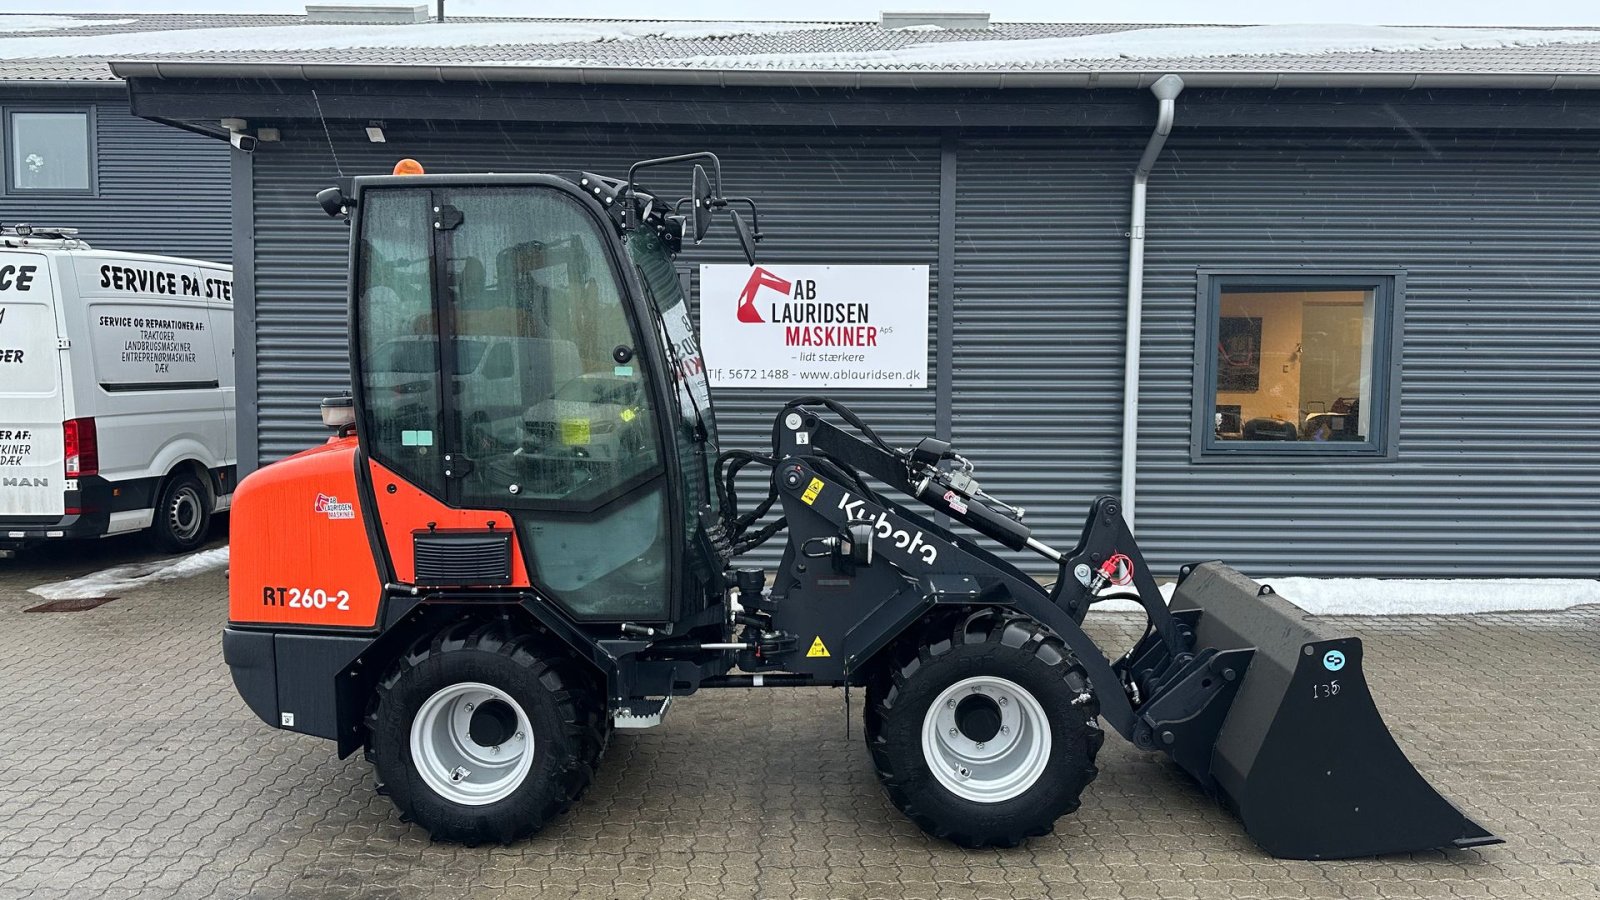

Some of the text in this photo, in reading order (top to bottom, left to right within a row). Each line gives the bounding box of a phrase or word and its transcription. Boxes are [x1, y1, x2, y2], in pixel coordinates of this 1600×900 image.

[100, 264, 233, 301] SERVICE PÅ STE
[794, 279, 817, 300] AB
[772, 303, 869, 323] LAURIDSEN
[100, 316, 205, 331] SERVICE OG REPARATIONER AF:
[140, 330, 175, 341] TRAKTORER
[786, 326, 893, 347] MASKINER ApS
[124, 341, 191, 352] LANDBRUGSMASKINER
[121, 352, 196, 362] ENTREPRENØRMASKINER
[800, 352, 816, 362] lidt
[818, 352, 865, 362] stærkere
[154, 363, 169, 373] DÆK
[708, 369, 725, 381] Tlf.
[729, 369, 757, 380] 5672
[760, 369, 789, 380] 1488
[800, 369, 921, 380] www.ablauridsen.dk
[15, 430, 32, 440] AF:
[0, 444, 31, 455] KINER
[3, 477, 48, 487] MAN
